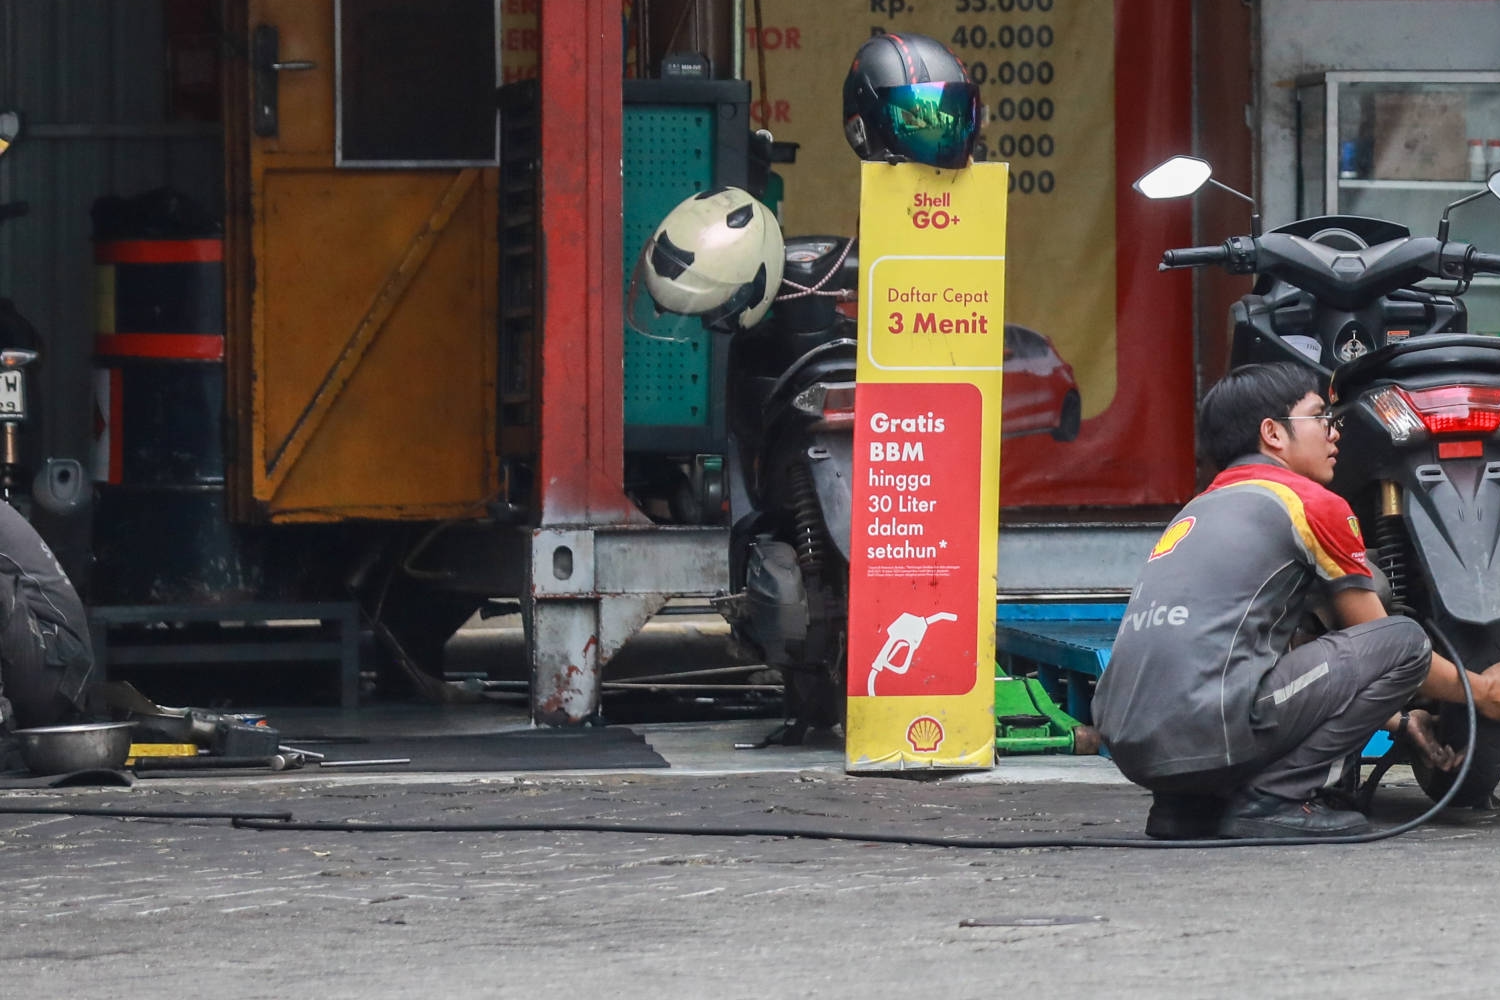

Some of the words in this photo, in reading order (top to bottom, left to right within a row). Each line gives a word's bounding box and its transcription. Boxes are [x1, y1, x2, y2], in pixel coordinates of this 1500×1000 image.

[951, 24, 1054, 49] 40.000
[970, 61, 1054, 86] 0.000
[914, 192, 950, 208] Shell
[912, 210, 960, 230] GO+
[888, 287, 938, 303] Daftar
[943, 288, 989, 307] Cepat
[888, 312, 904, 334] 3
[913, 312, 988, 334] Menit
[870, 411, 945, 433] Gratis
[870, 442, 924, 462] BBM
[868, 468, 931, 491] hingga
[868, 495, 892, 513] 30
[898, 495, 937, 513] Liter
[867, 517, 924, 536] dalam
